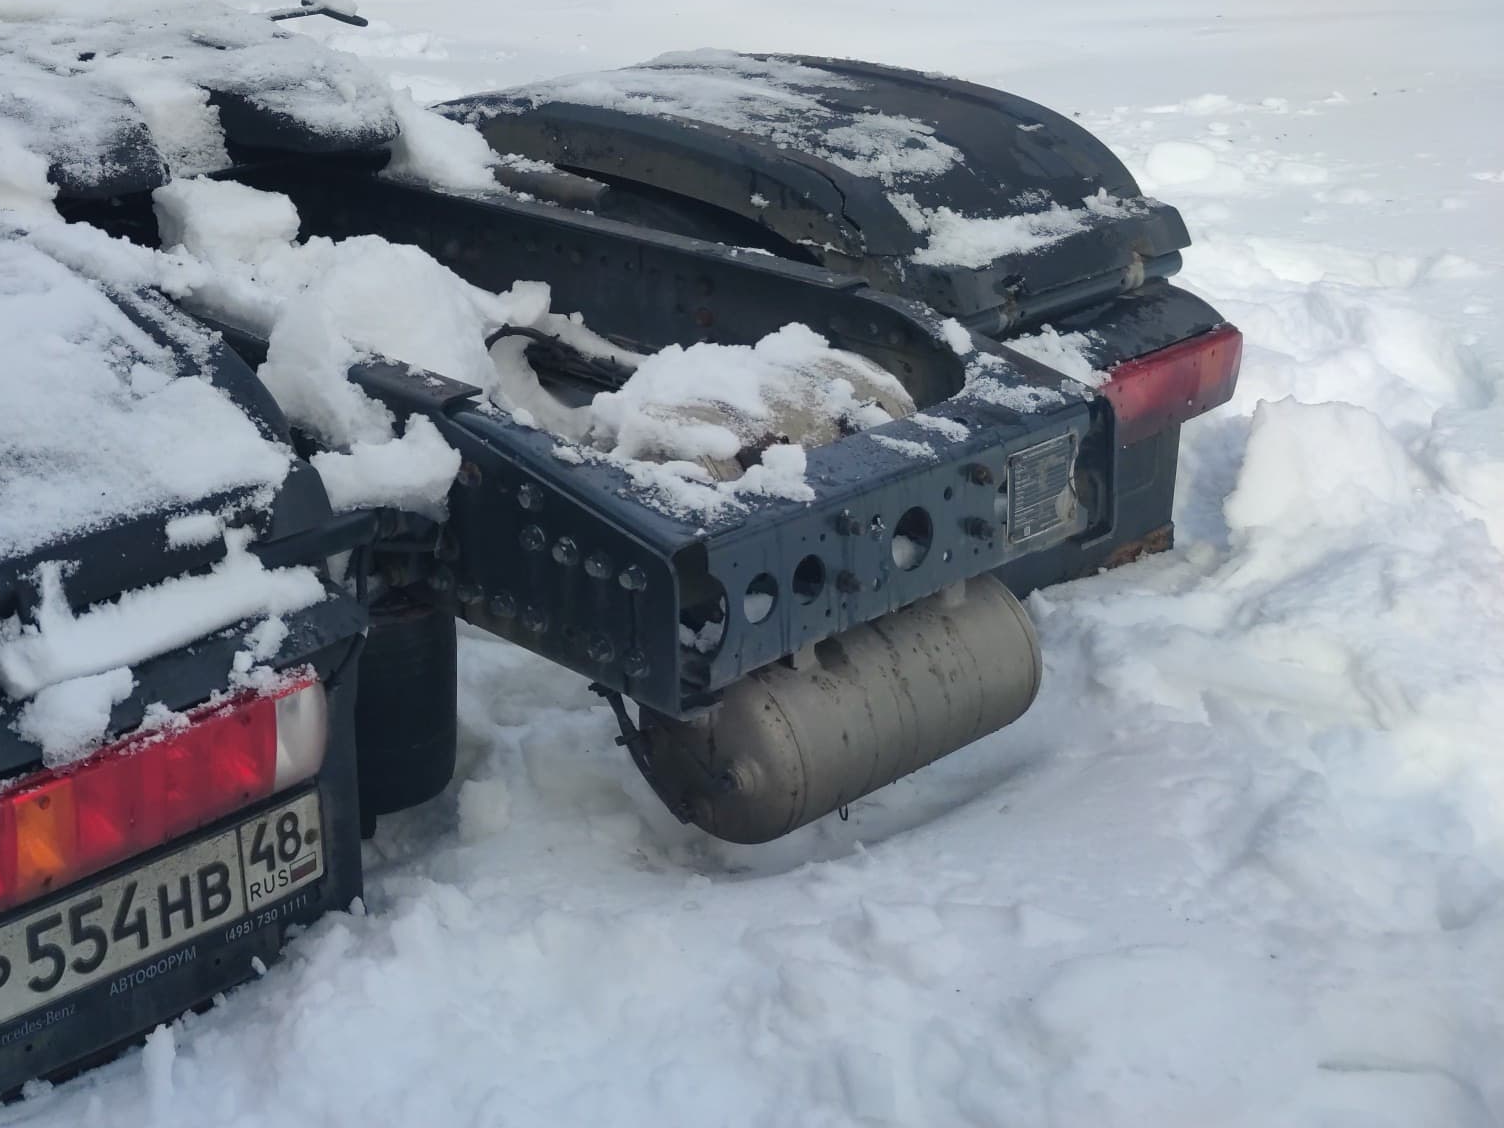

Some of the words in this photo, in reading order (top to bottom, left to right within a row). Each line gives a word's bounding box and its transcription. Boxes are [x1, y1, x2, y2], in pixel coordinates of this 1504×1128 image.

[249, 811, 303, 872] 48
[249, 871, 289, 903] RUS
[224, 918, 255, 944] (495)
[256, 908, 279, 929] 730
[281, 893, 308, 916] 1111
[109, 944, 198, 998] АВТОФОРУМ
